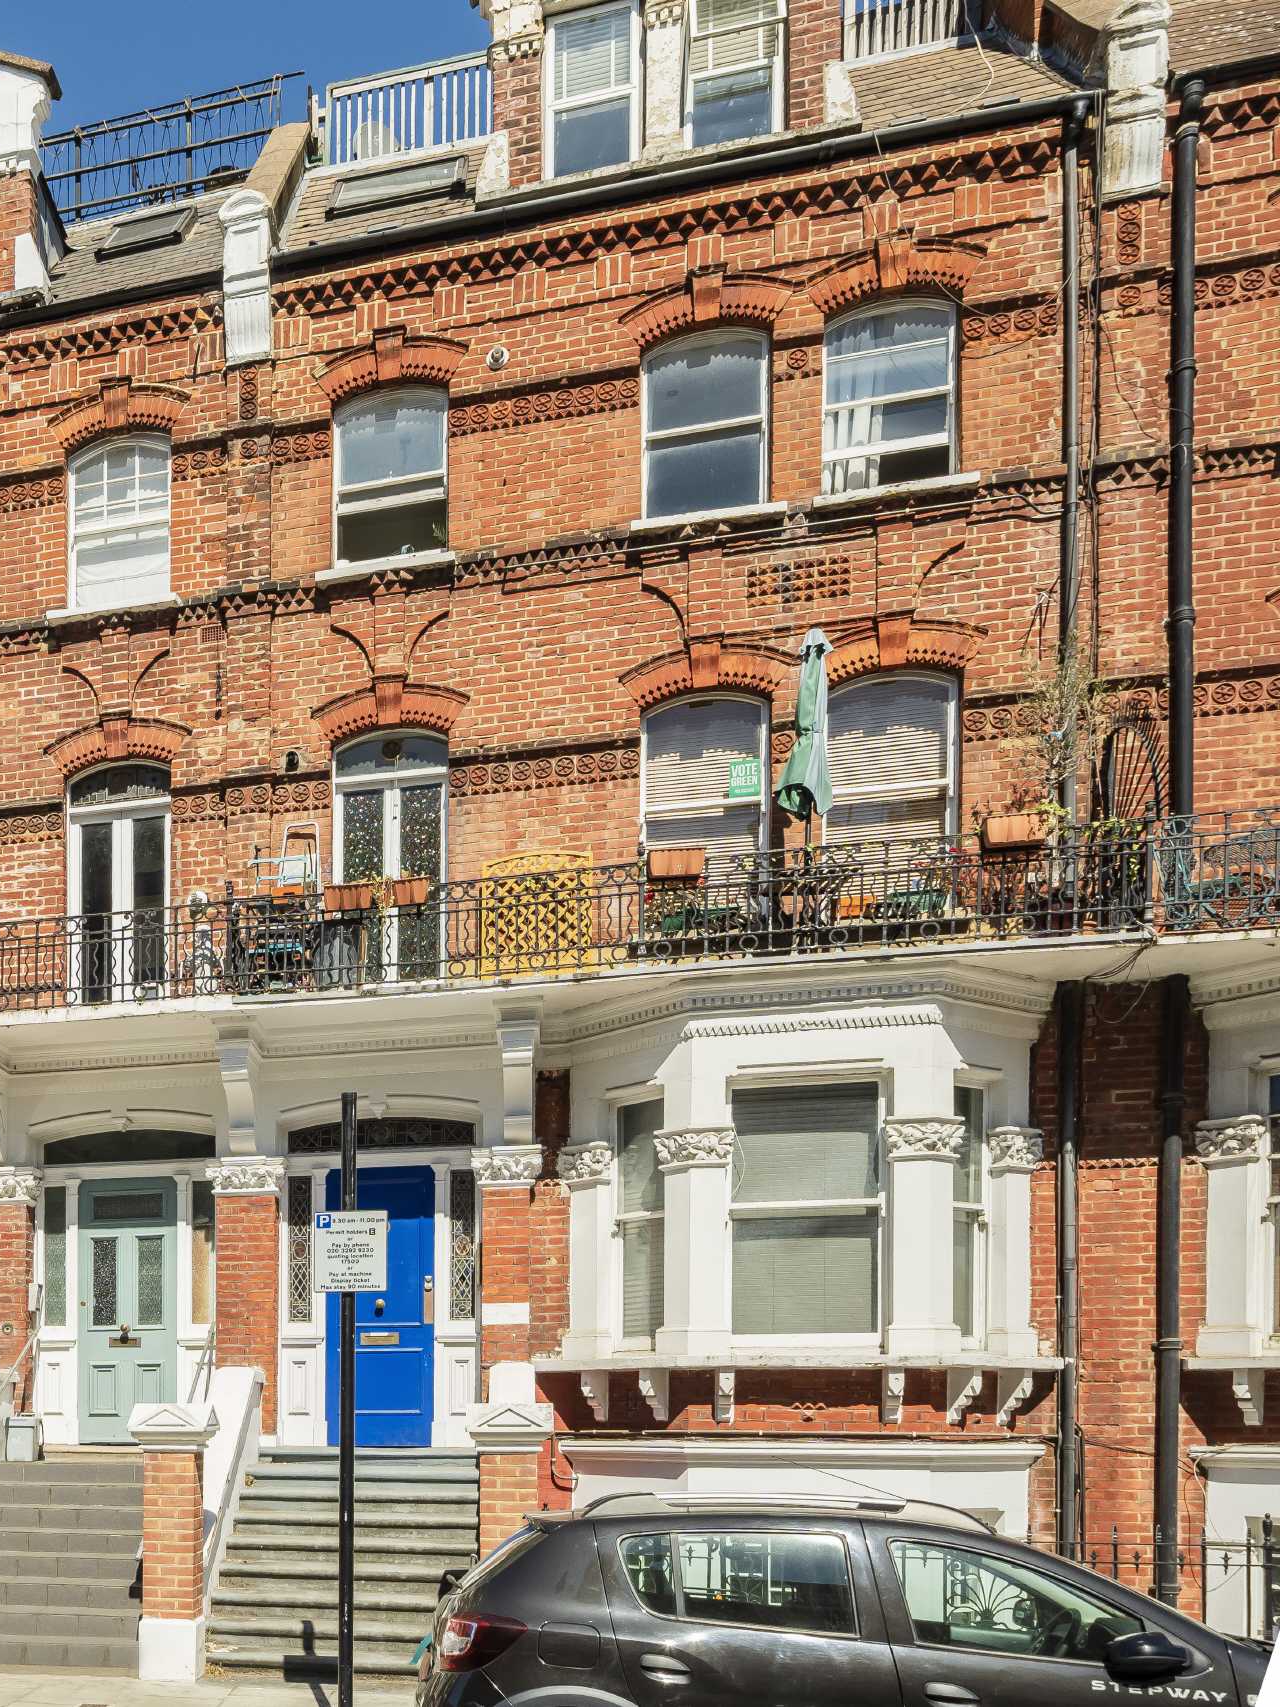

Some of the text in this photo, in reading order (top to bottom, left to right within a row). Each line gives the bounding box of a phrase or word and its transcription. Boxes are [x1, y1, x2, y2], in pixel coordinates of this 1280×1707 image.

[731, 763, 758, 776] VOTE
[731, 775, 758, 786] GREEN
[320, 1215, 329, 1227] P
